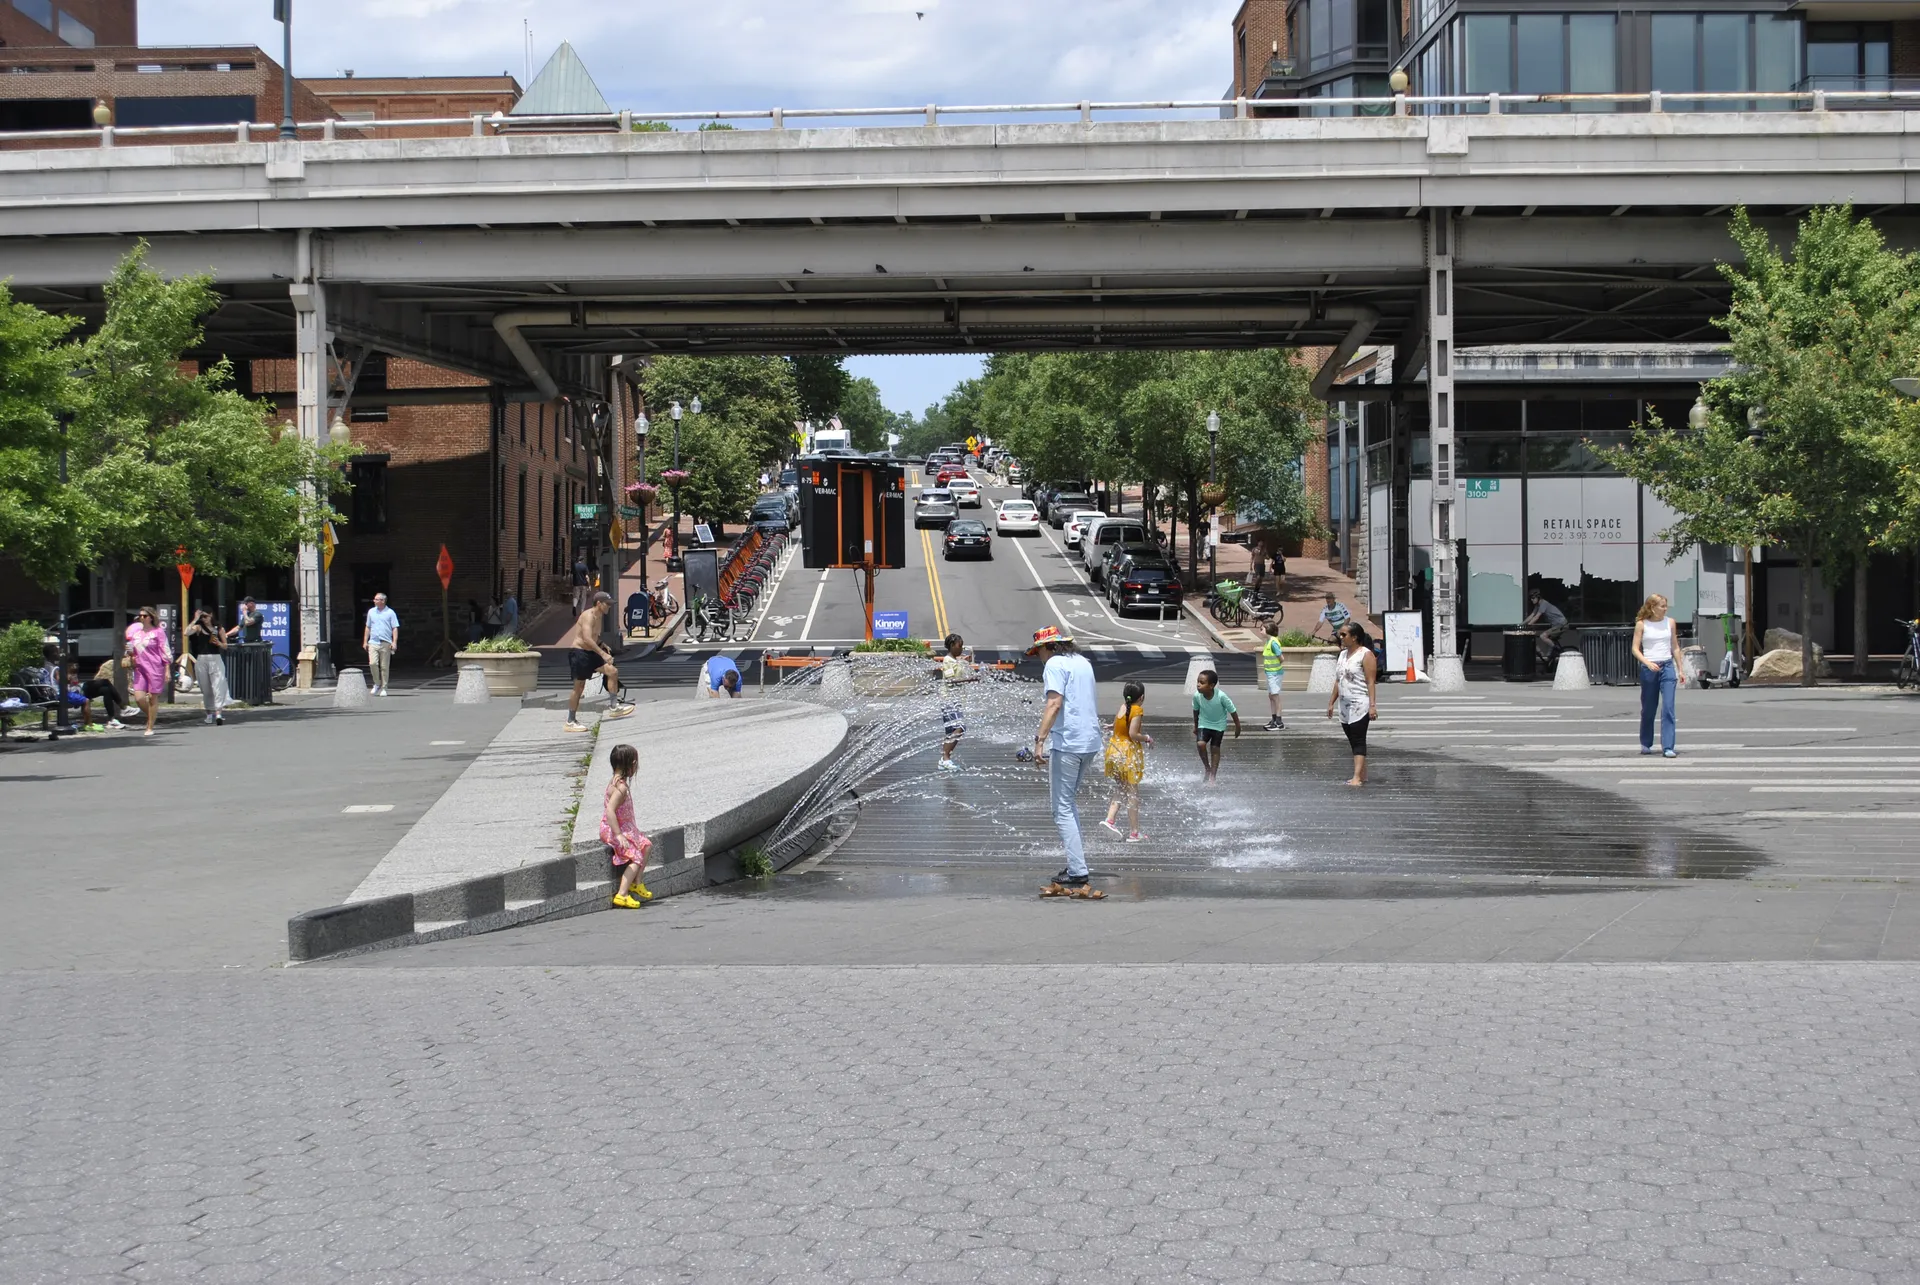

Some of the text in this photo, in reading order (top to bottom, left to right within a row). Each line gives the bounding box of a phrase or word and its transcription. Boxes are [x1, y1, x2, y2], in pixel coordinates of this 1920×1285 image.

[1475, 480, 1482, 490] K
[1467, 490, 1487, 498] 3100
[1543, 518, 1621, 529] RETAIL SPACE
[1543, 531, 1622, 540] 202.393.7000
[272, 604, 286, 612] $16
[272, 617, 287, 625] $14
[875, 619, 905, 630] Kinney
